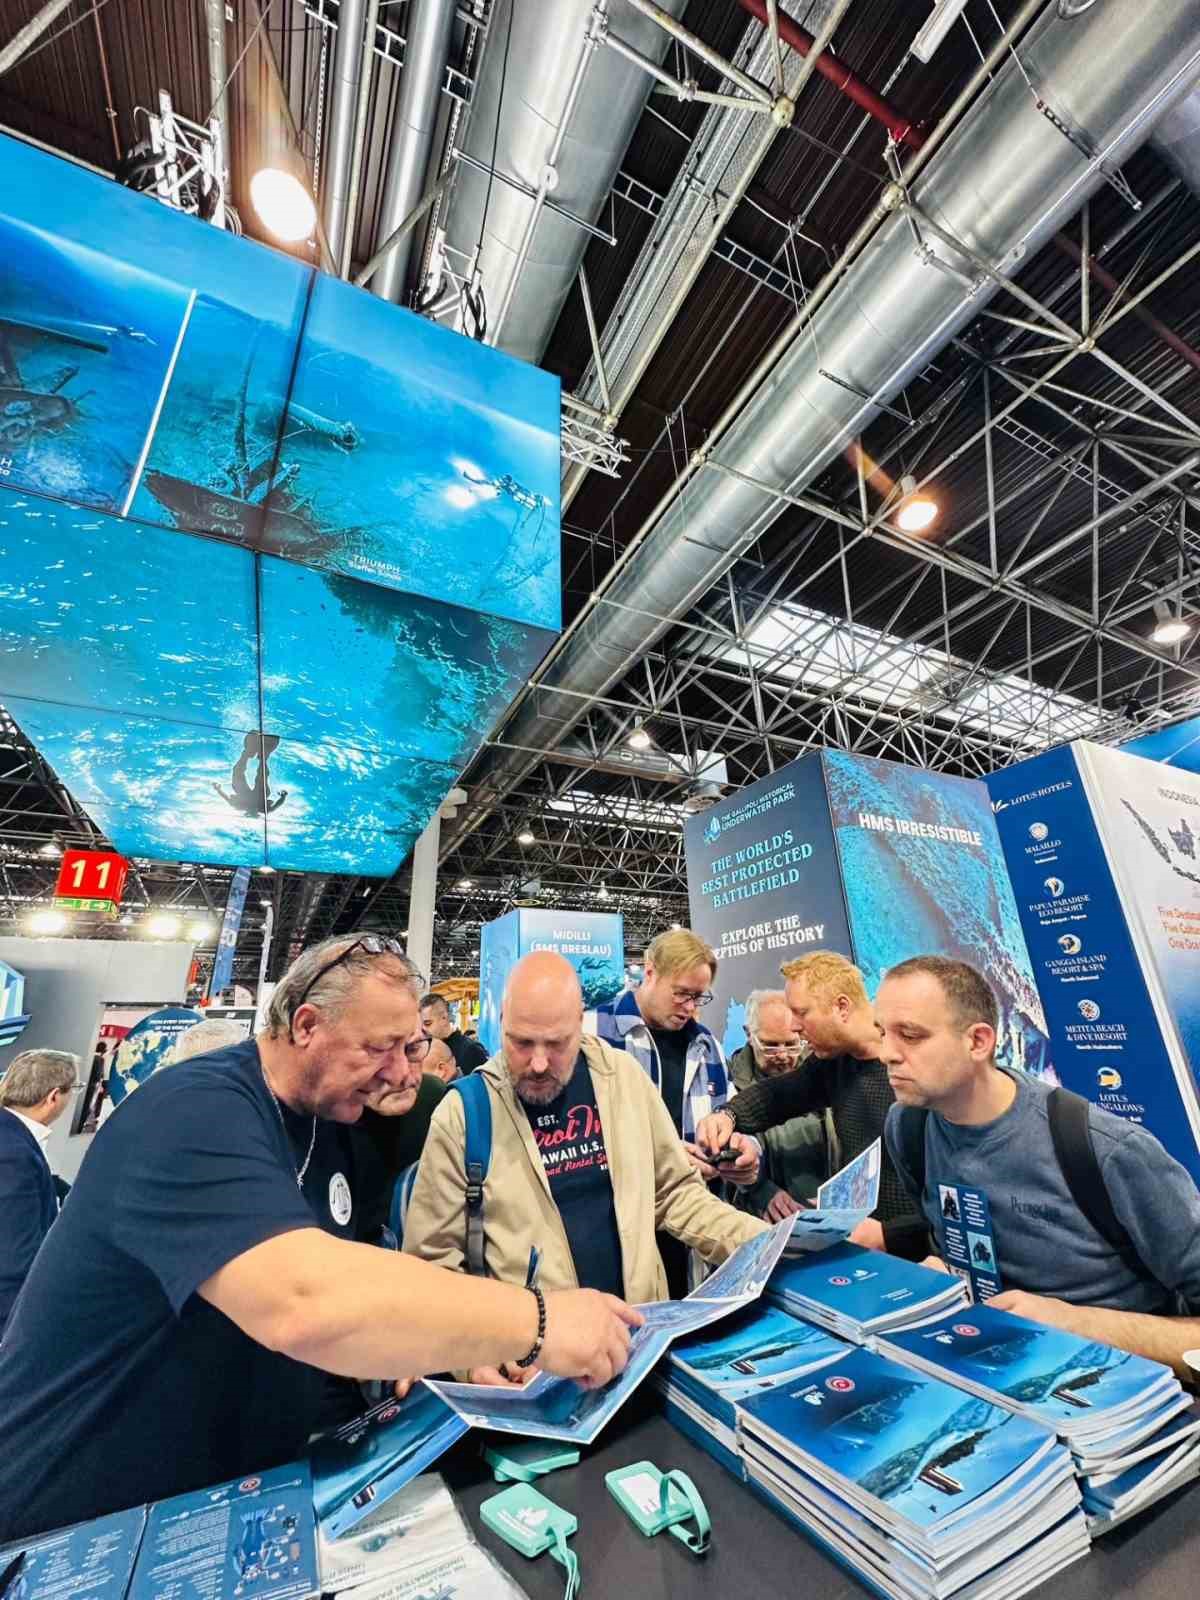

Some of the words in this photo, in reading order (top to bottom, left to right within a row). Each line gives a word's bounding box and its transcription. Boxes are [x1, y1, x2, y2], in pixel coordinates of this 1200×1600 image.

[353, 554, 401, 571] TRIUMPH
[732, 799, 759, 818] GALLIPOLI
[759, 782, 794, 804] HISTORICAL
[1010, 792, 1038, 806] LOTUS
[1038, 781, 1073, 797] HOTELS
[722, 802, 771, 831] UNDERWATER
[772, 789, 796, 807] PARK
[859, 813, 895, 833] HMS
[896, 820, 983, 847] IRRESISTIBLE
[711, 855, 733, 874] THE
[735, 830, 793, 863] WORLD'S
[701, 875, 729, 895] BEST
[731, 843, 813, 884] PROTECTED
[712, 868, 800, 908] BATTLEFIELD
[1029, 901, 1053, 911] PAPUA
[1054, 894, 1090, 908] PARADISE
[1038, 908, 1054, 917] ECO
[1054, 904, 1083, 915] RESORT
[721, 921, 772, 945] EXPLORE
[775, 914, 801, 931] THE
[561, 943, 612, 957] BRESLAU)
[713, 943, 747, 960] EPTHS
[749, 939, 765, 953] OF
[767, 924, 825, 950] HISTORY
[1045, 957, 1076, 968] GANGGA
[1076, 953, 1107, 964] ISLAND
[1051, 965, 1080, 976] RESORT
[1088, 962, 1105, 972] SPA
[1073, 1033, 1094, 1041] DIVE
[1095, 1032, 1128, 1041] RESORT
[1096, 1024, 1126, 1032] BEACH
[1099, 1093, 1128, 1103] LOTUS
[1095, 1102, 1145, 1113] NGALOWS
[537, 1115, 559, 1127] EST.
[541, 1147, 577, 1165] AWAII
